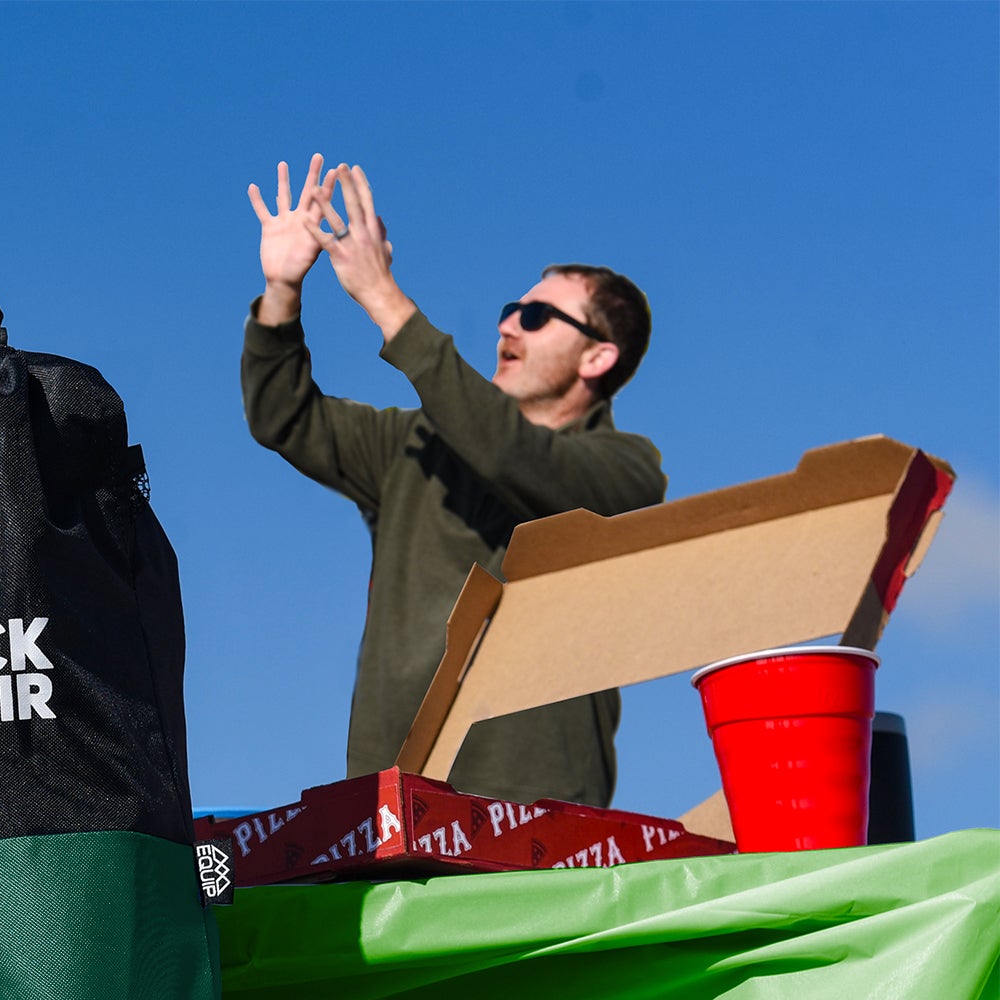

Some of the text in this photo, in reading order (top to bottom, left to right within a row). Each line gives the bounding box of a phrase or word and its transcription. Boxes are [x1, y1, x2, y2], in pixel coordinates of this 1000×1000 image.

[233, 806, 307, 857] PIZ
[311, 805, 400, 865] IZZA
[487, 802, 550, 837] PIZ
[196, 844, 217, 897] EQUIP
[552, 836, 626, 868] ZZA
